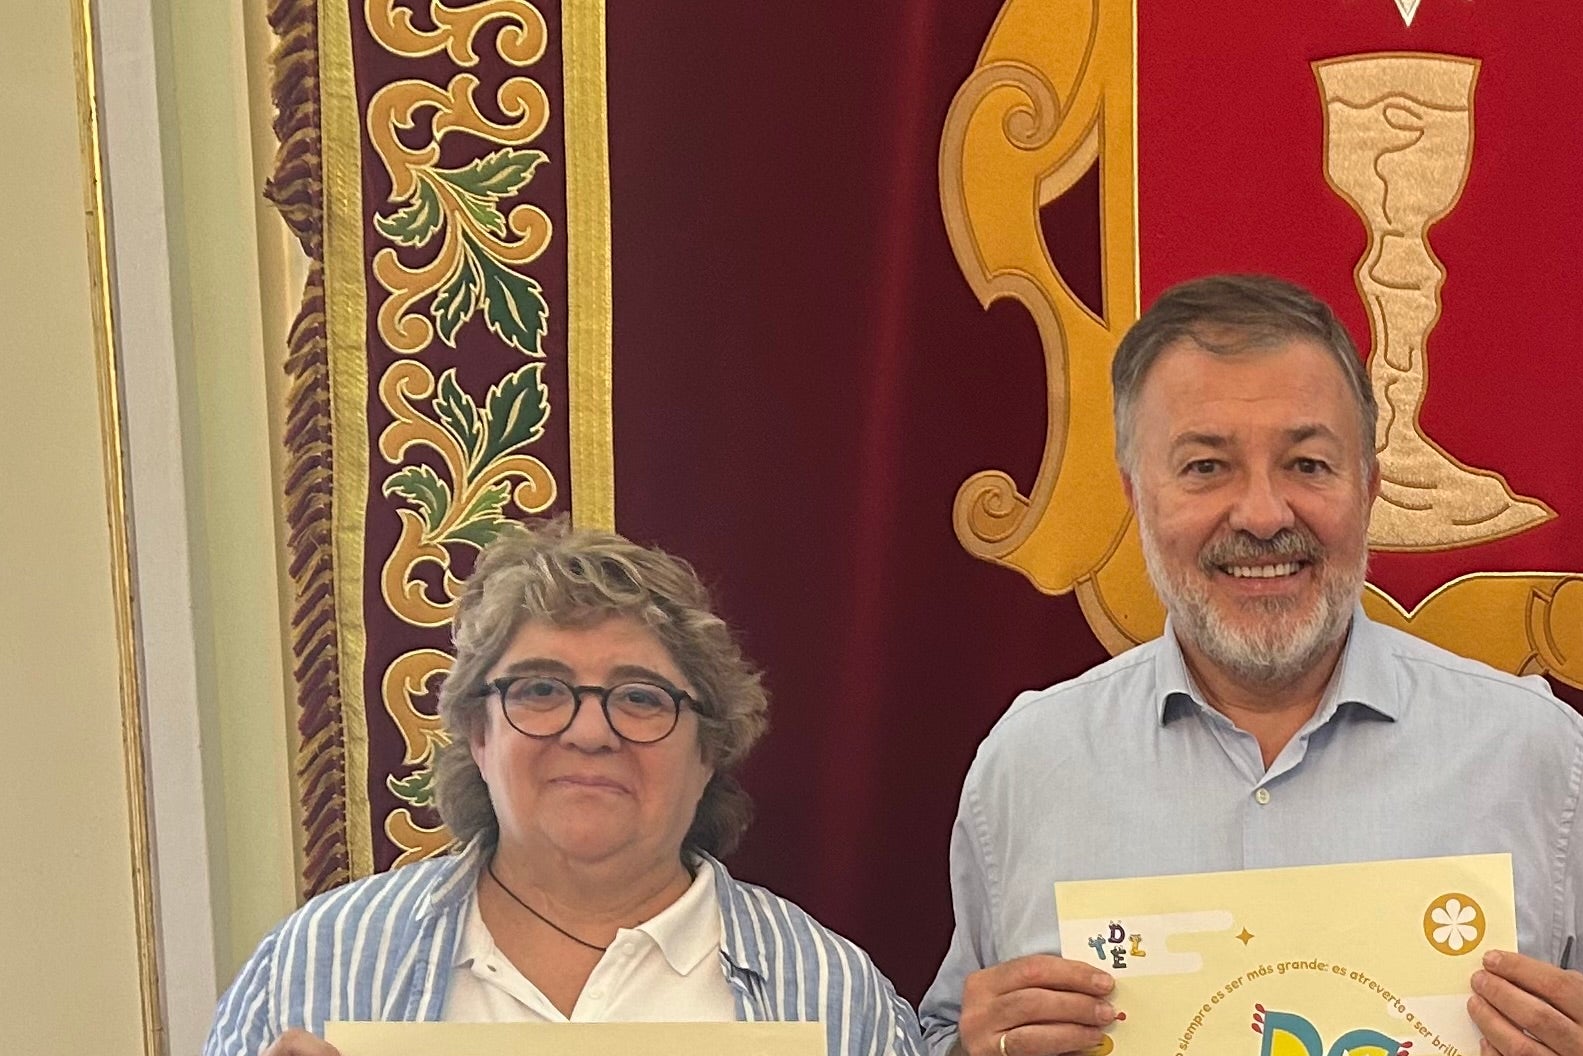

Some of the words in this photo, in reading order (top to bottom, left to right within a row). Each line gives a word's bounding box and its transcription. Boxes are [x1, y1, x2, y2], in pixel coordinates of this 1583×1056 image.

[1178, 1004, 1212, 1050] siempre
[1211, 991, 1225, 1004] es
[1225, 976, 1243, 993] ser
[1246, 965, 1274, 981] más
[1332, 965, 1347, 976] es
[1350, 971, 1406, 1013] atreverte
[1414, 1021, 1432, 1037] ser
